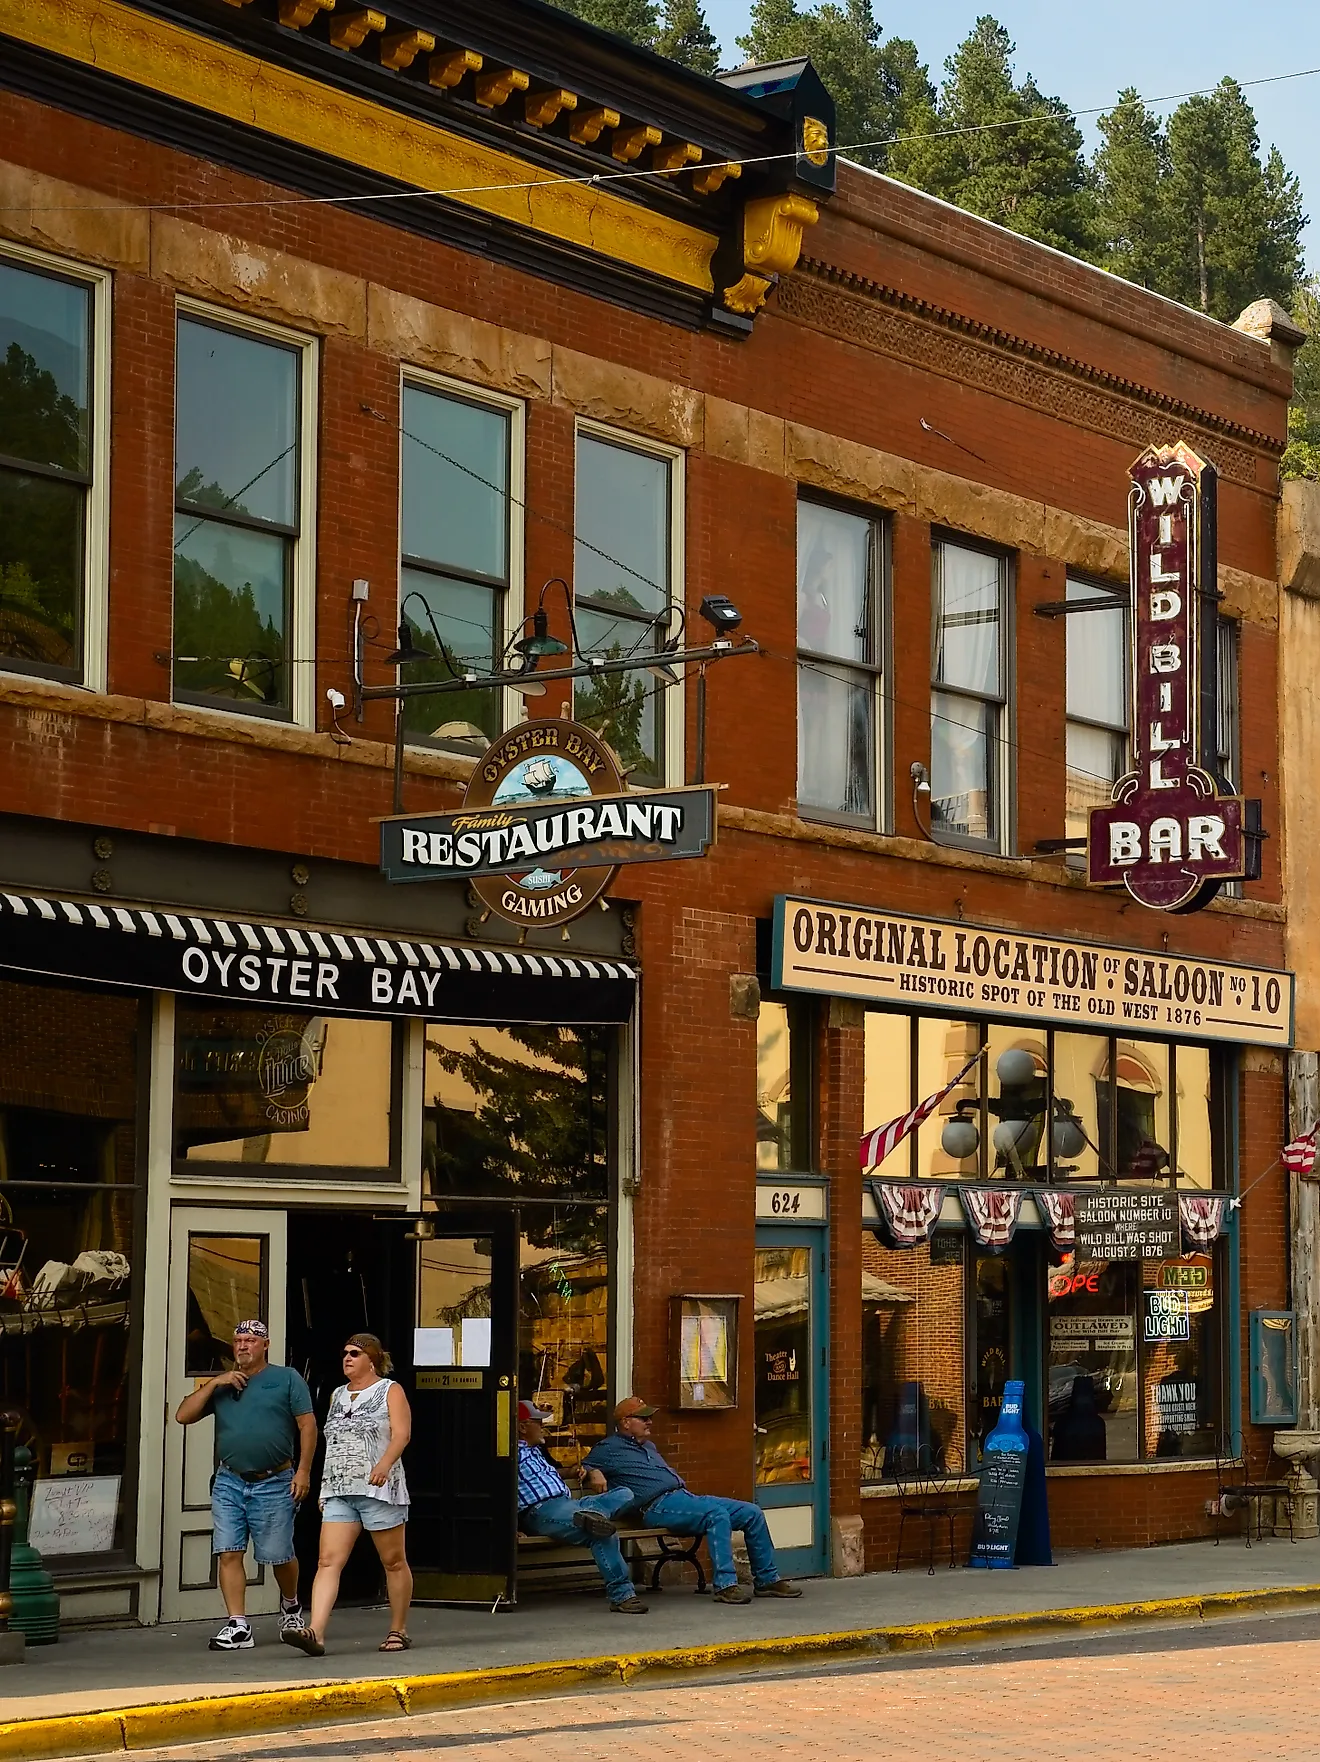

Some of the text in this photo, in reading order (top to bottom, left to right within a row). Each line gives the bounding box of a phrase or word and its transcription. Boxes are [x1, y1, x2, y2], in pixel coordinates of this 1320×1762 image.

[1149, 475, 1185, 790] WILD BILL
[483, 727, 606, 783] OYSTER BAY
[452, 813, 527, 835] Family
[401, 803, 681, 867] RESTAURANT
[1109, 816, 1228, 867] BAR
[501, 883, 584, 917] GAMING
[793, 908, 946, 970] ORIGINAL
[954, 932, 1098, 991] LOCATION
[1104, 957, 1120, 974] OF
[1124, 957, 1225, 1006] SALOON
[1252, 976, 1280, 1014] 10
[182, 946, 441, 1007] OYSTER BAY
[900, 973, 1201, 1025] HISTORIC SPOT OF THE OLD WEST 1876
[266, 1104, 308, 1124] CASINO
[771, 1192, 800, 1213] 624
[1088, 1195, 1164, 1209] HISTORIC SITE
[1080, 1211, 1117, 1223] SALOON
[1120, 1209, 1160, 1222] NUMBER
[1115, 1222, 1137, 1231] WHERE
[1080, 1231, 1173, 1245] WILD BILL WAS SHOT
[1092, 1246, 1129, 1257] AUGUST
[1141, 1246, 1162, 1257] 1876
[1150, 1295, 1180, 1315] BUD
[1054, 1322, 1129, 1330] OUTLAWED
[1144, 1316, 1186, 1336] LIGHT
[765, 1350, 787, 1362] Theater
[442, 1375, 450, 1385] 21
[767, 1370, 799, 1381] Dance Hall
[1179, 1383, 1196, 1400] YOU
